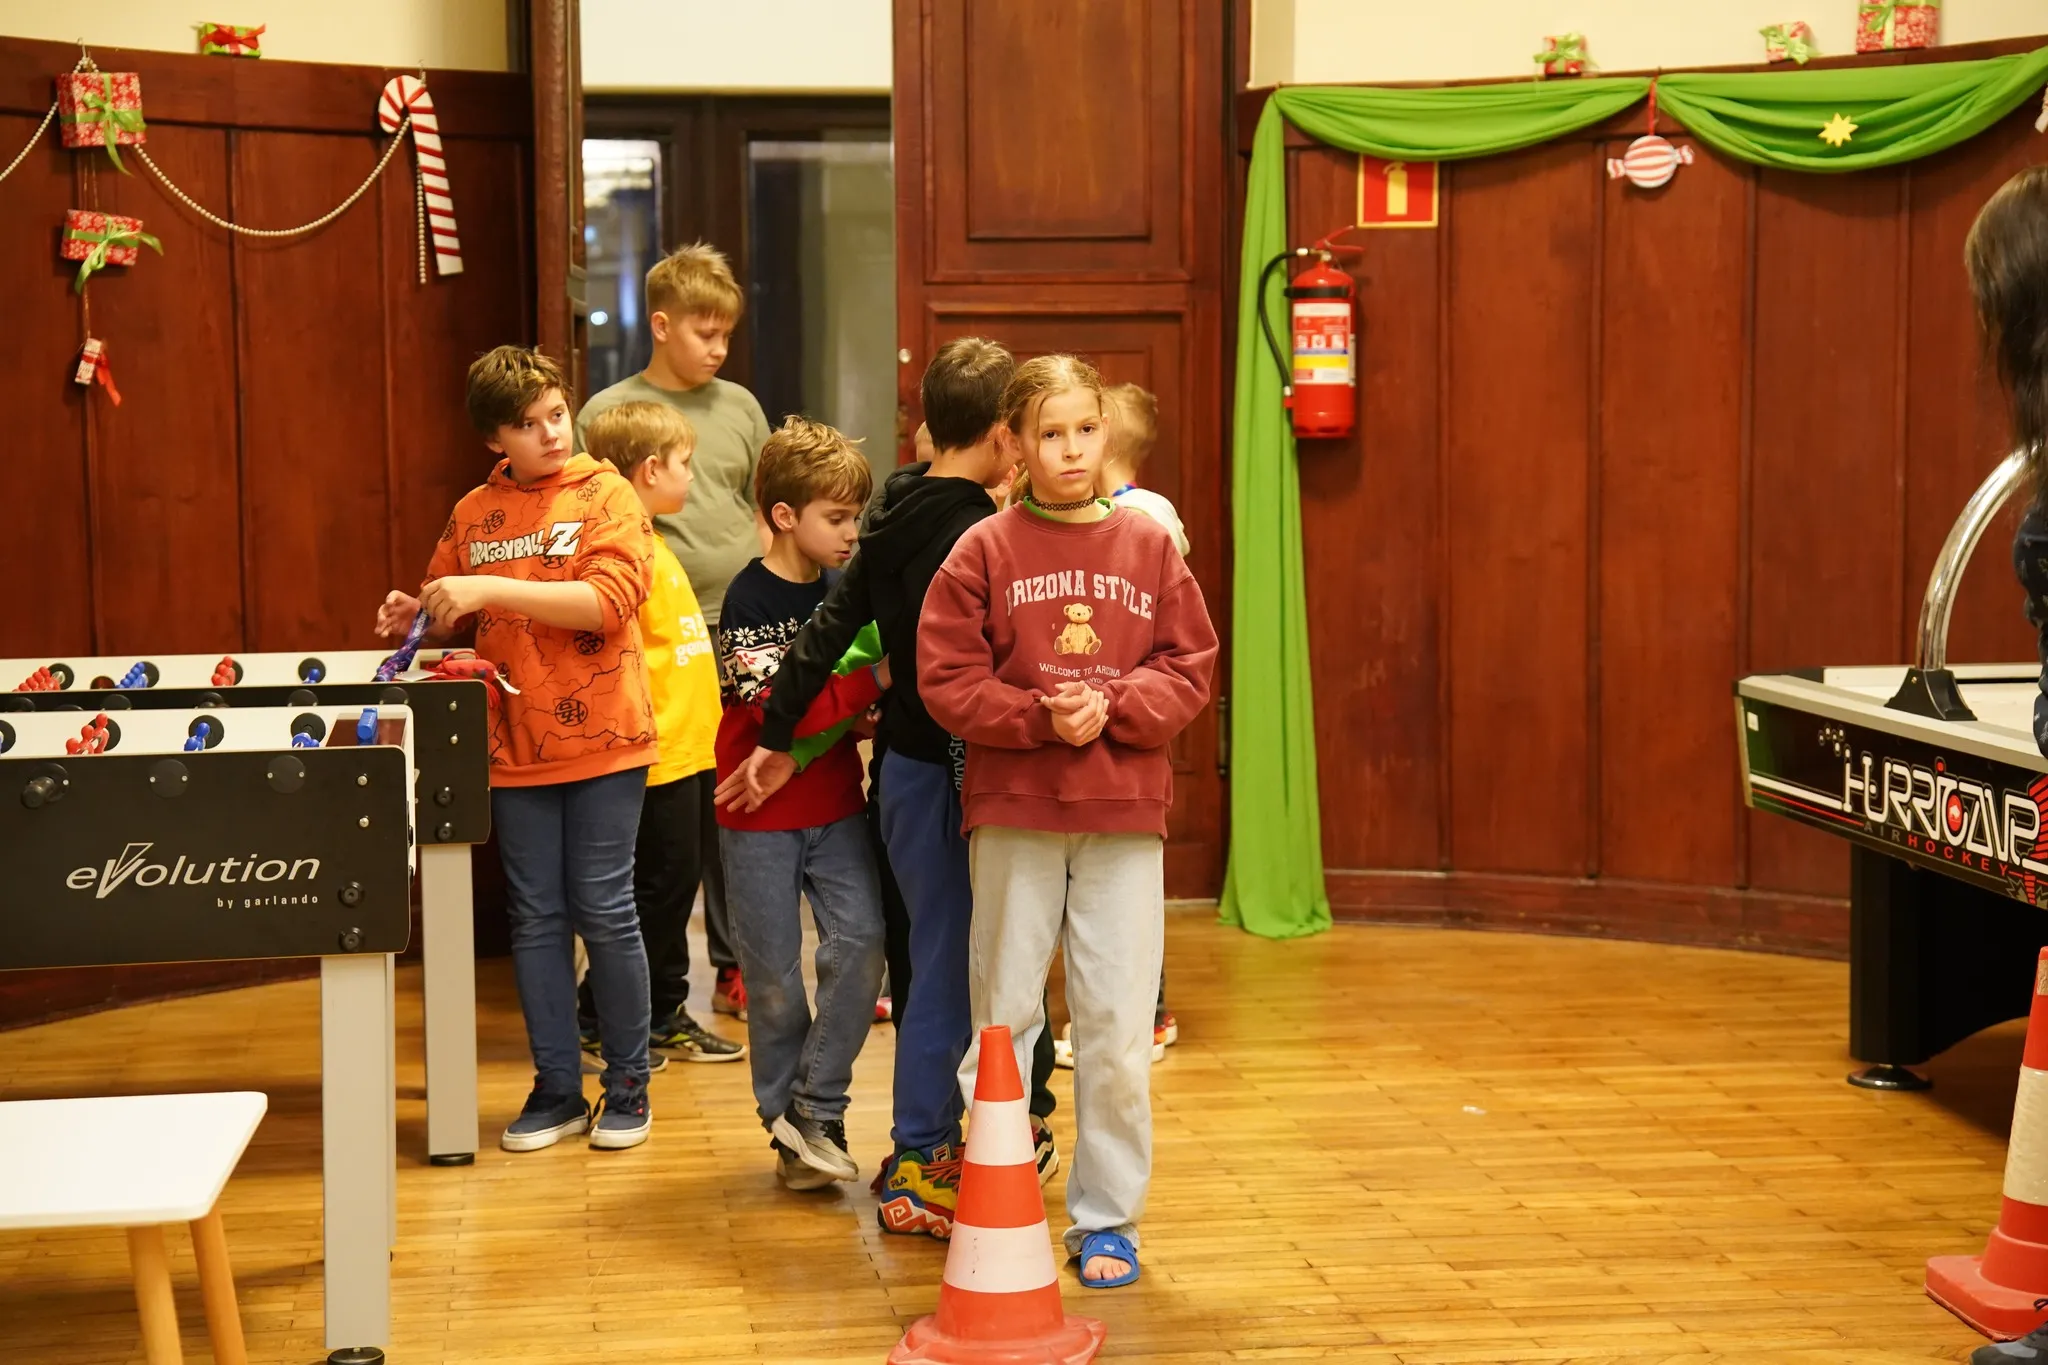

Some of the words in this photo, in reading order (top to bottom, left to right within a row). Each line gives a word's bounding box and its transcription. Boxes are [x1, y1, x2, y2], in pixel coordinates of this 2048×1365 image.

[545, 521, 583, 556] Z
[1093, 573, 1152, 620] STYLE
[1039, 662, 1081, 678] WELCOME
[1083, 666, 1093, 677] TO
[1842, 750, 2040, 867] HURRICANE
[217, 897, 235, 909] by
[244, 894, 320, 909] garlando
[890, 1175, 908, 1189] FILA
